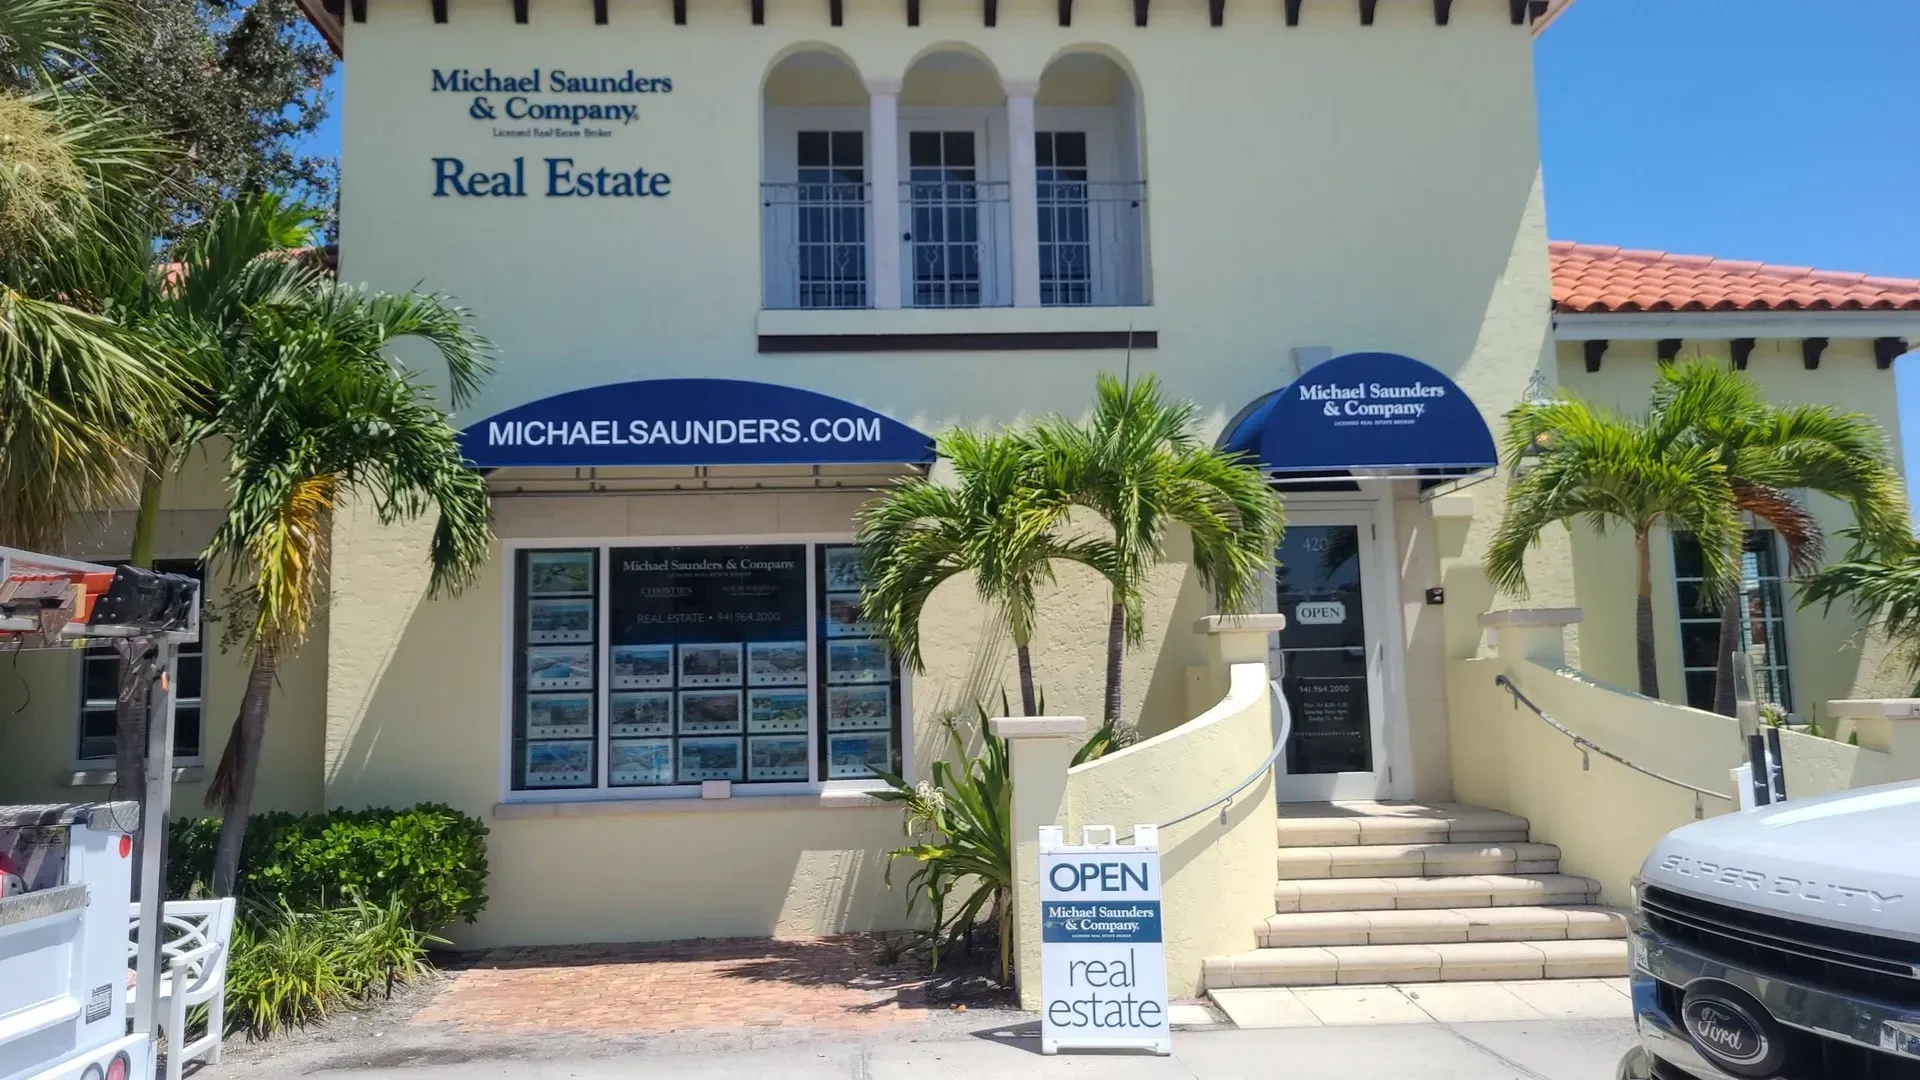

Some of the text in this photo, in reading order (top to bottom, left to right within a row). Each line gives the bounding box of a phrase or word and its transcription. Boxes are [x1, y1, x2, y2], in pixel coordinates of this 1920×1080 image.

[431, 68, 673, 94] Michael Saunders
[469, 96, 497, 120] &
[533, 128, 553, 138] Real
[431, 156, 671, 198] Real Estate
[1299, 381, 1445, 401] Michael Saunders
[1323, 400, 1341, 416] &
[488, 417, 881, 447] MICHAELSAUNDERS.COM
[1302, 536, 1328, 553] 420
[623, 560, 669, 572] Michael
[671, 559, 723, 571] Saunders
[725, 559, 738, 570] &
[637, 614, 664, 625] REAL
[668, 613, 705, 623] ESTATE
[1301, 606, 1340, 619] OPEN
[1298, 684, 1350, 693] 941.964.2000
[1049, 862, 1149, 893] OPEN
[1660, 854, 1904, 913] SUPER DUTY
[1048, 905, 1154, 918] Michael Saunders
[1065, 919, 1079, 931] &
[1069, 947, 1136, 988] real
[1048, 991, 1162, 1029] estate
[1697, 1007, 1744, 1051] Ford
